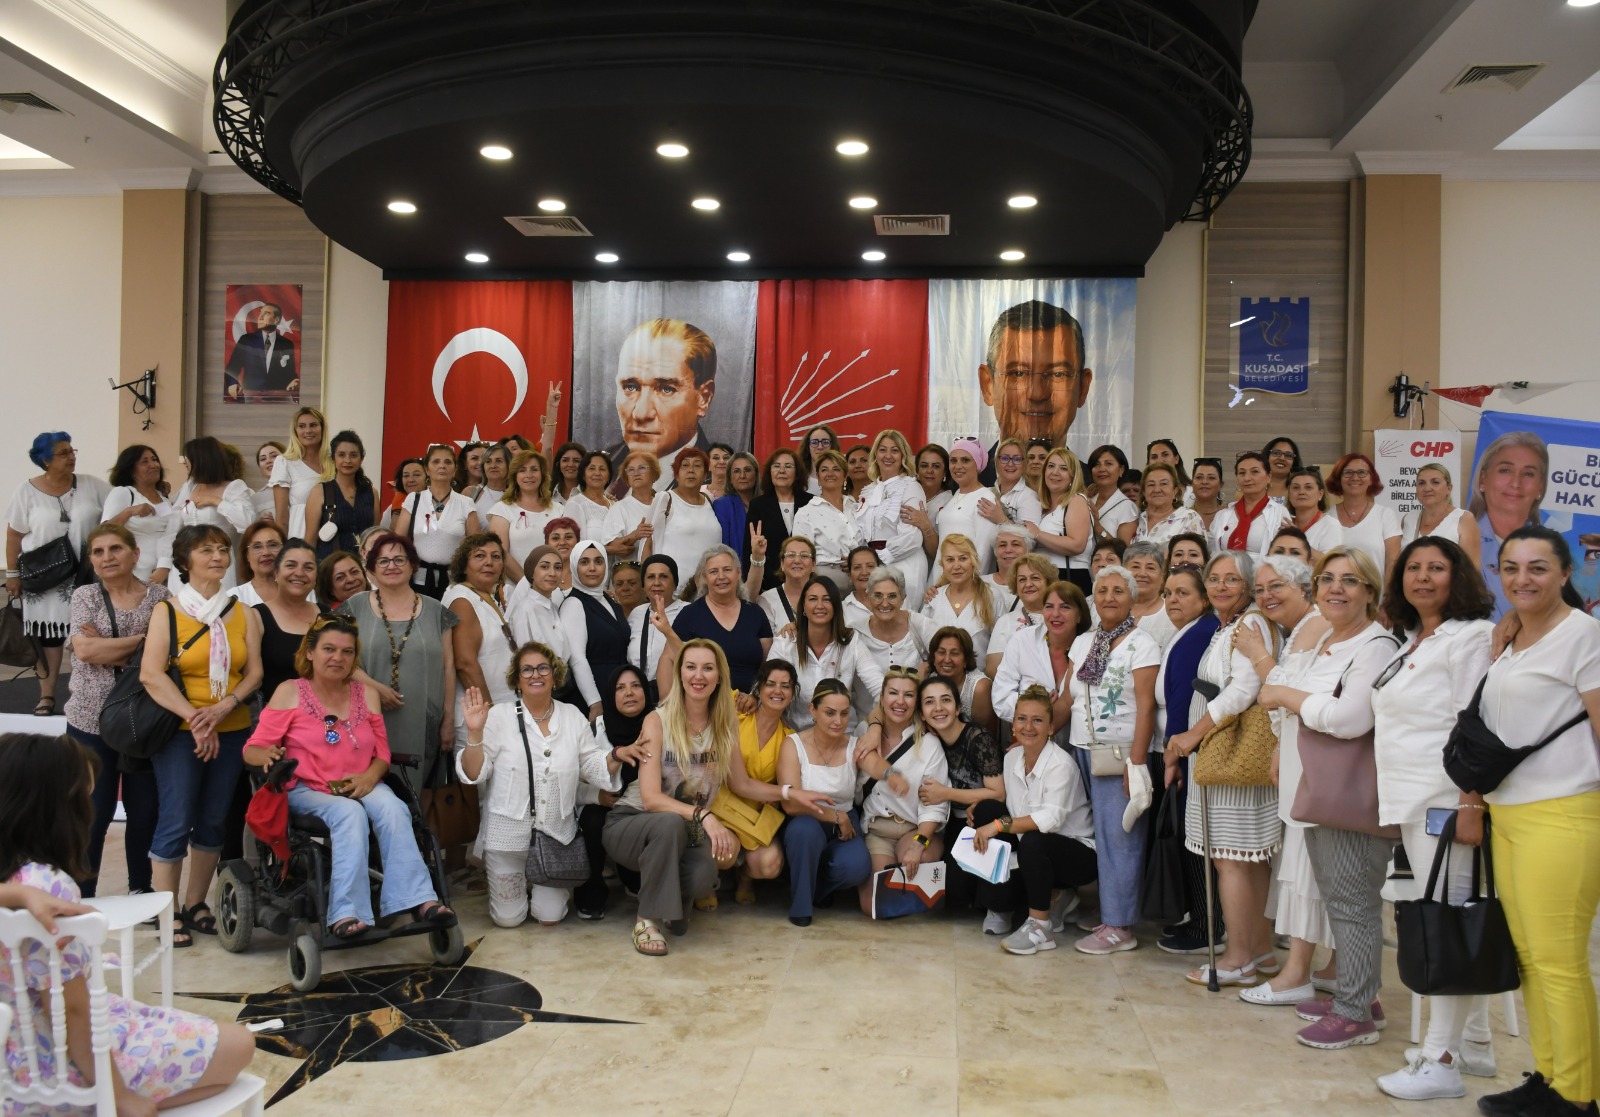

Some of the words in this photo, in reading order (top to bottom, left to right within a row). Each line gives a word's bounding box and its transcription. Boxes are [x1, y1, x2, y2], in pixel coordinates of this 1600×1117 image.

[1410, 441, 1454, 458] CHP
[1388, 478, 1411, 488] SAYFA
[1390, 490, 1417, 502] BİRLEŞT
[1555, 491, 1597, 508] HAK
